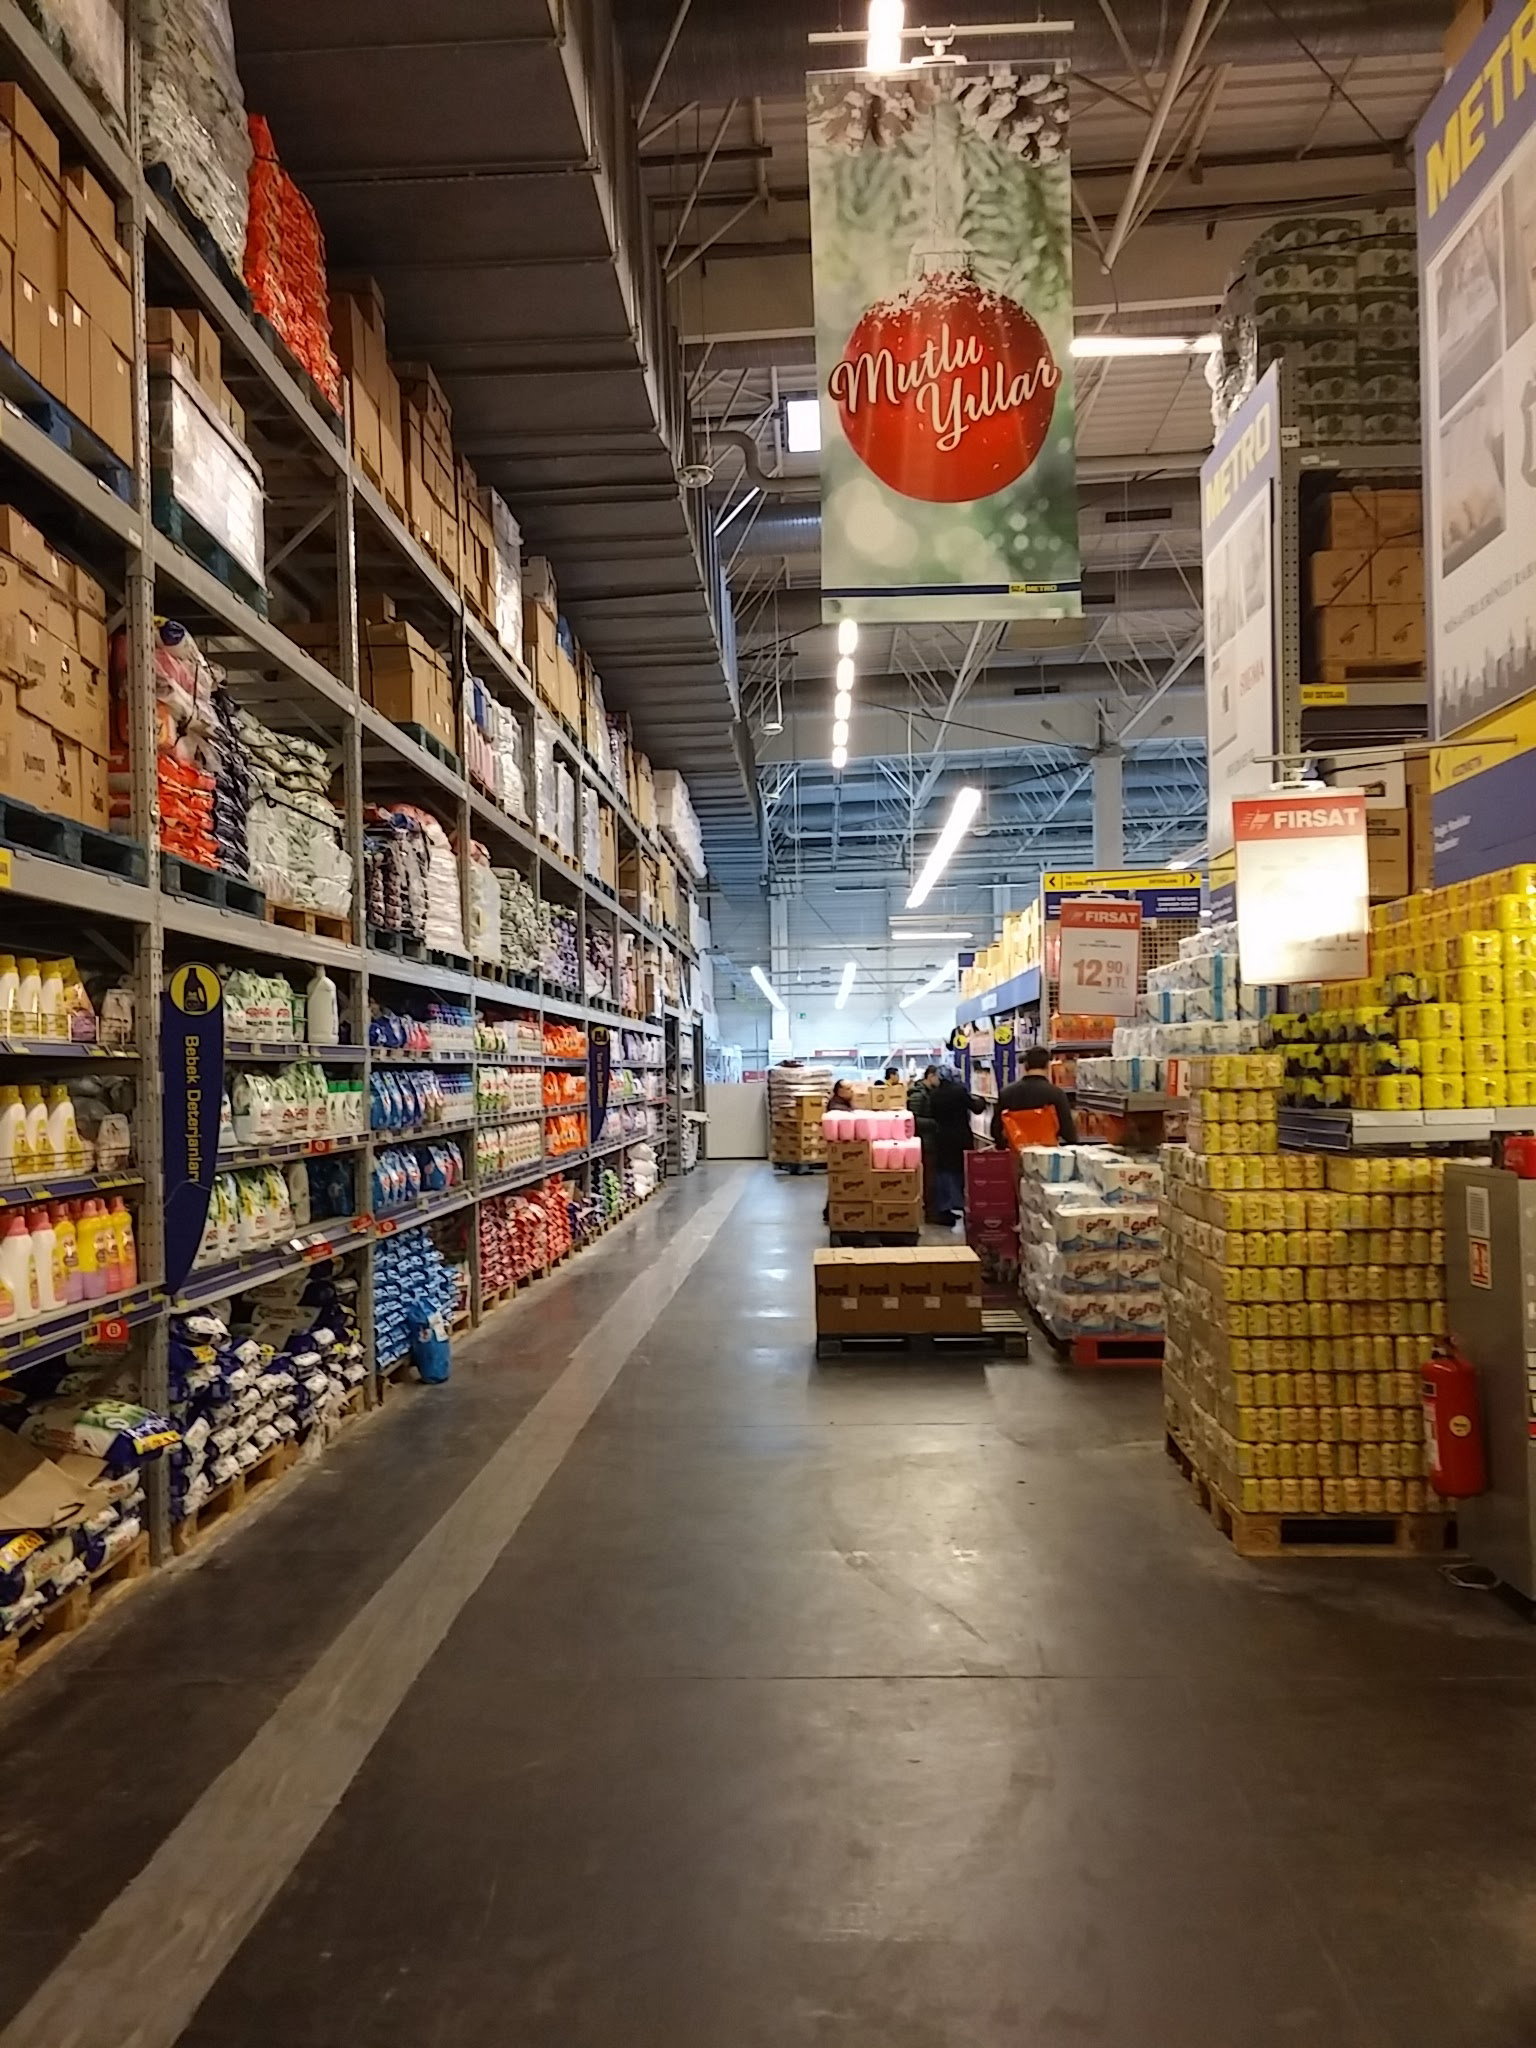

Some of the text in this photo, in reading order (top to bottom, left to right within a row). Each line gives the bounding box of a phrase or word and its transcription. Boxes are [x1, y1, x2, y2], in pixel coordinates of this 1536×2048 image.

[829, 323, 983, 413] Mutlu
[916, 361, 1057, 451] Yıllar
[1205, 402, 1271, 529] METRO
[1273, 807, 1359, 829] FIRSAT
[1085, 911, 1138, 924] FIRSAT
[185, 1036, 200, 1084] Bebek
[1131, 1216, 1158, 1236] Soft
